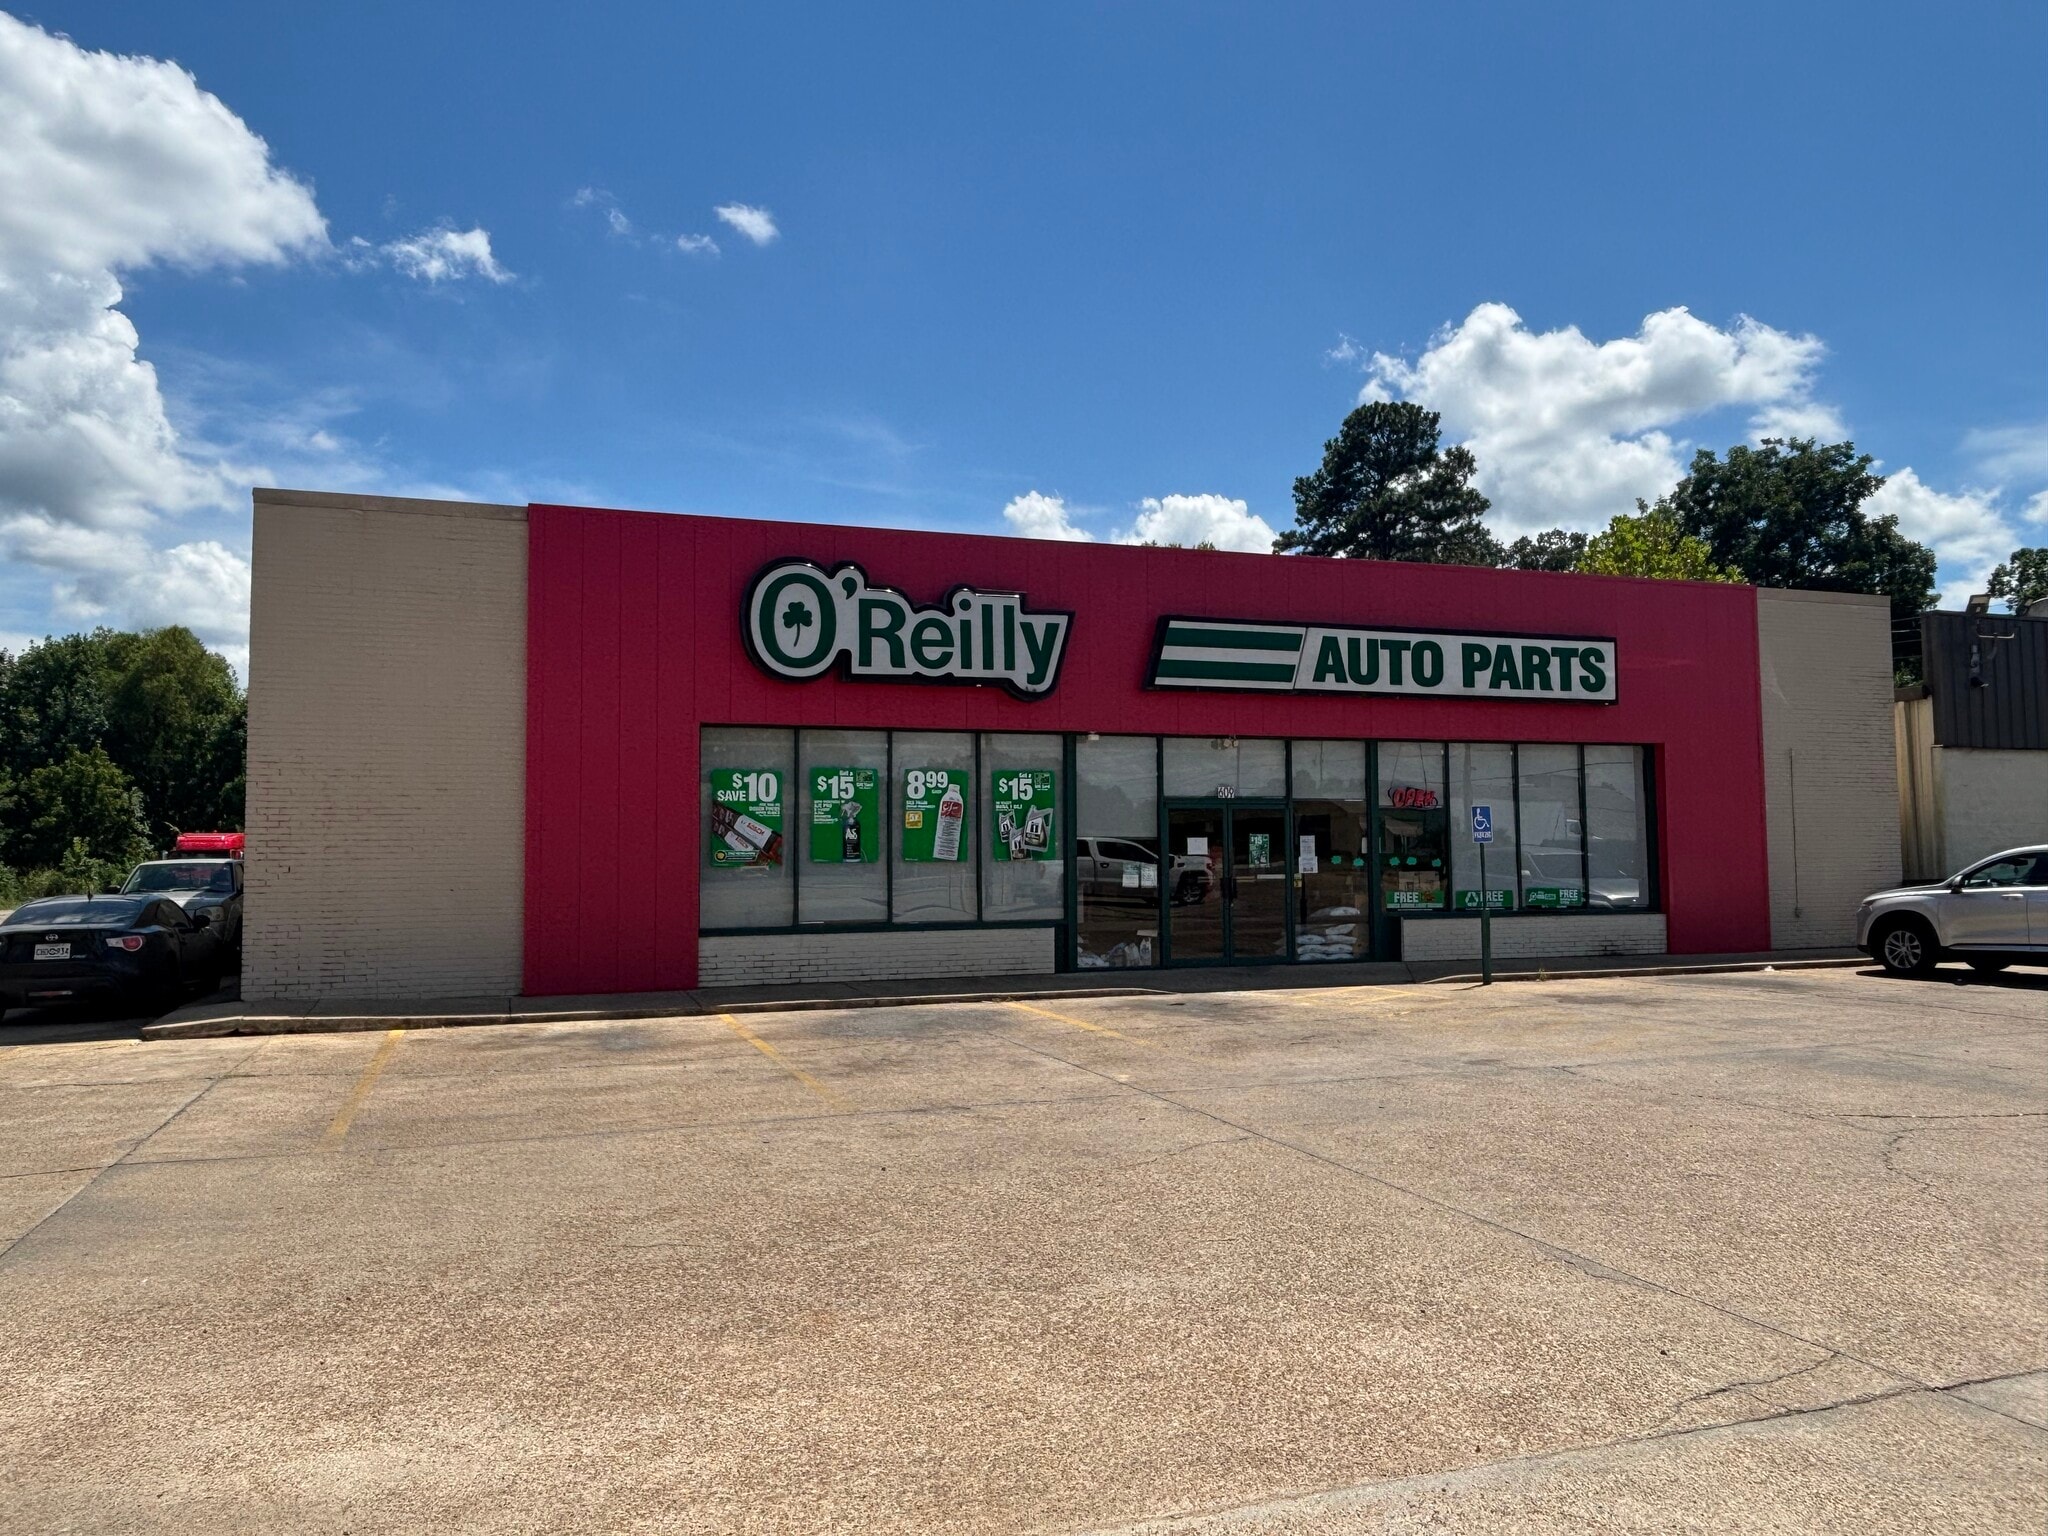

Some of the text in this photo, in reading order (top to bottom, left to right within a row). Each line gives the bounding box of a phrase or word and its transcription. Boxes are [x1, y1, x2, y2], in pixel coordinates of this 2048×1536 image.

[759, 573, 1060, 685] O'Reilly
[1312, 635, 1606, 693] AUTO PARTS
[717, 790, 747, 801] SAVE
[817, 775, 855, 799] $15
[998, 777, 1034, 800] $15
[1394, 891, 1419, 903] FREE
[1559, 889, 1578, 898] FREE
